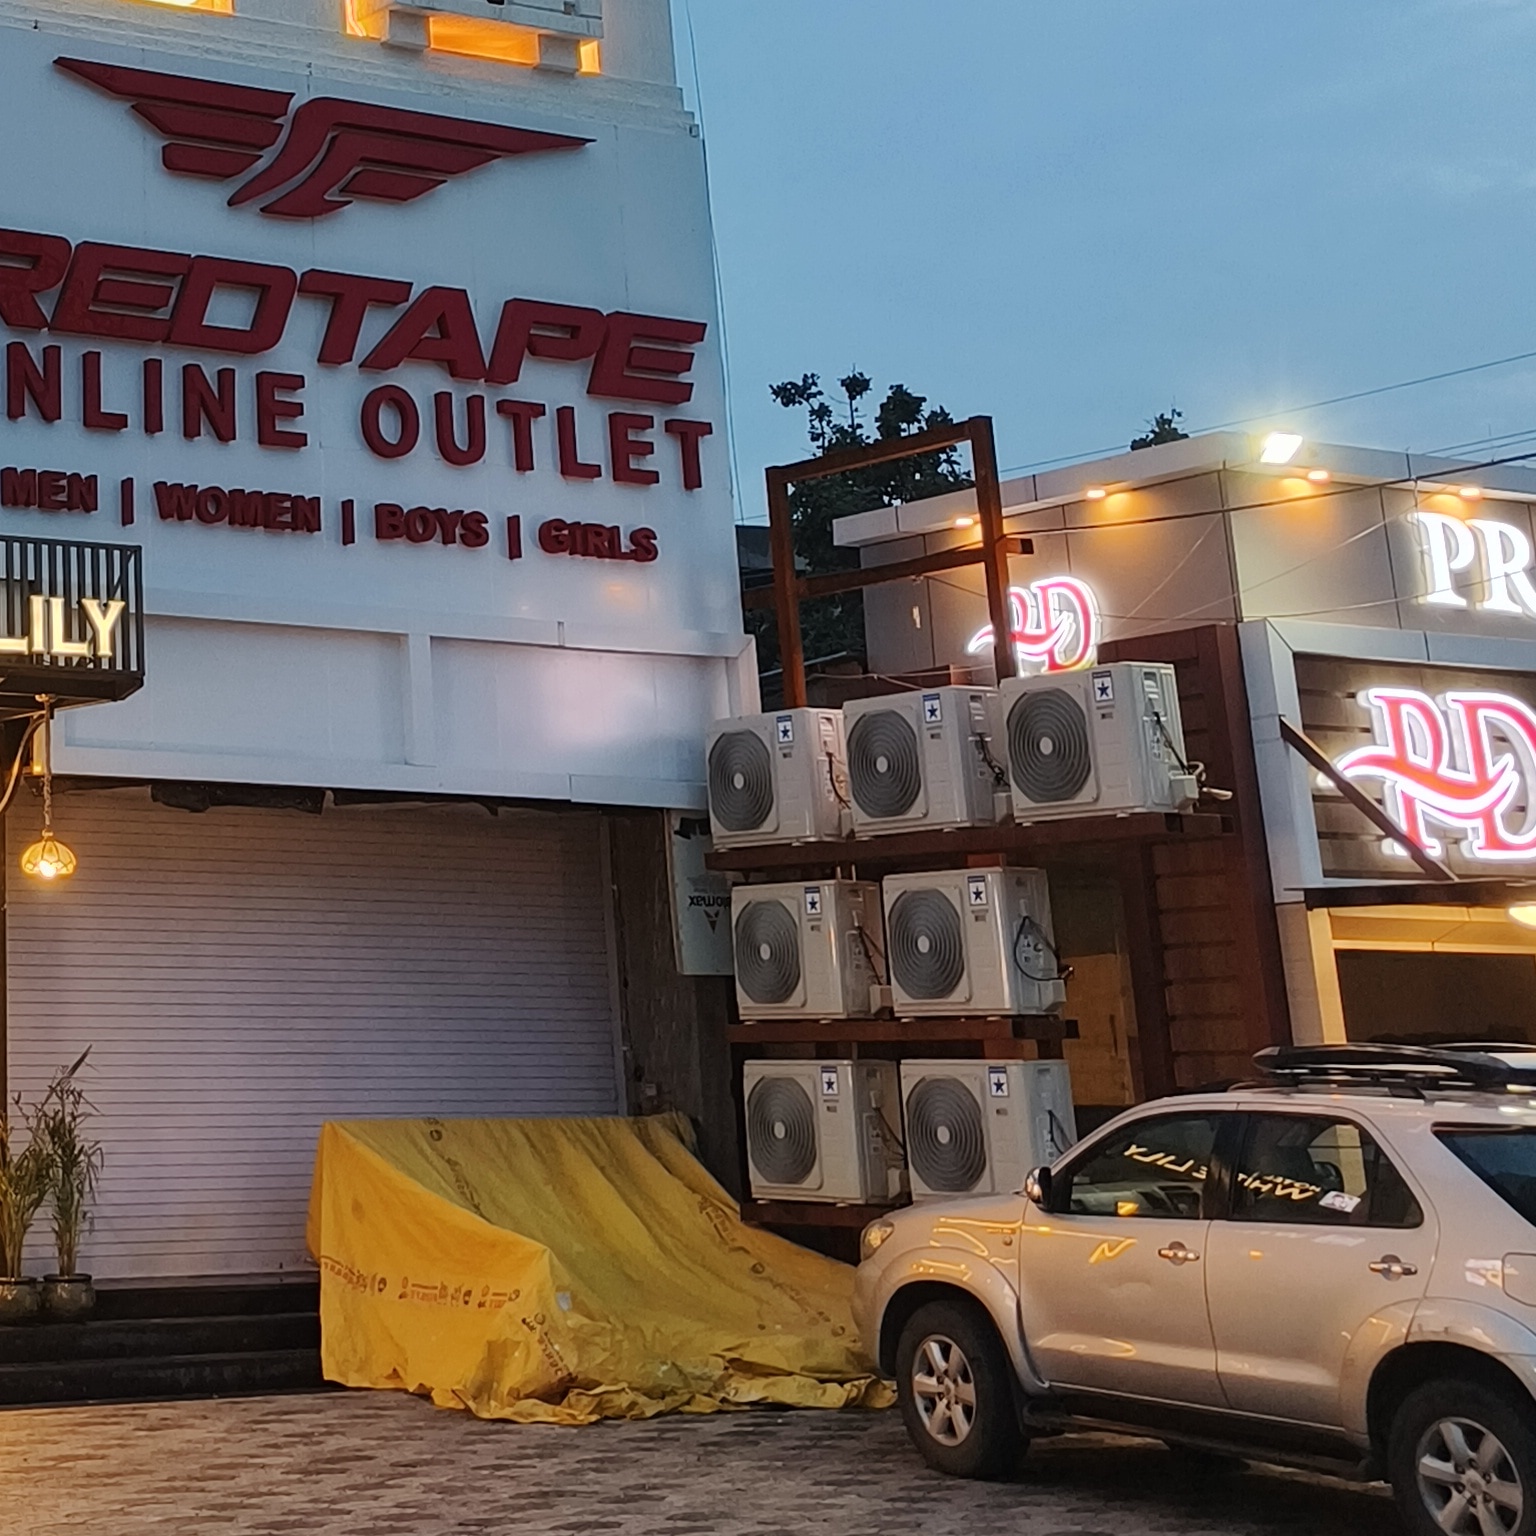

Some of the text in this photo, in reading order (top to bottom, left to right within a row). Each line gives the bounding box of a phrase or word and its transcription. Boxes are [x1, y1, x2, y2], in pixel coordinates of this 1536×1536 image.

[360, 383, 714, 491] OUTLET
[0, 467, 98, 513] MEN
[153, 481, 321, 533] WOMEN
[375, 503, 489, 547] BOYS
[538, 518, 658, 563] GIRLS
